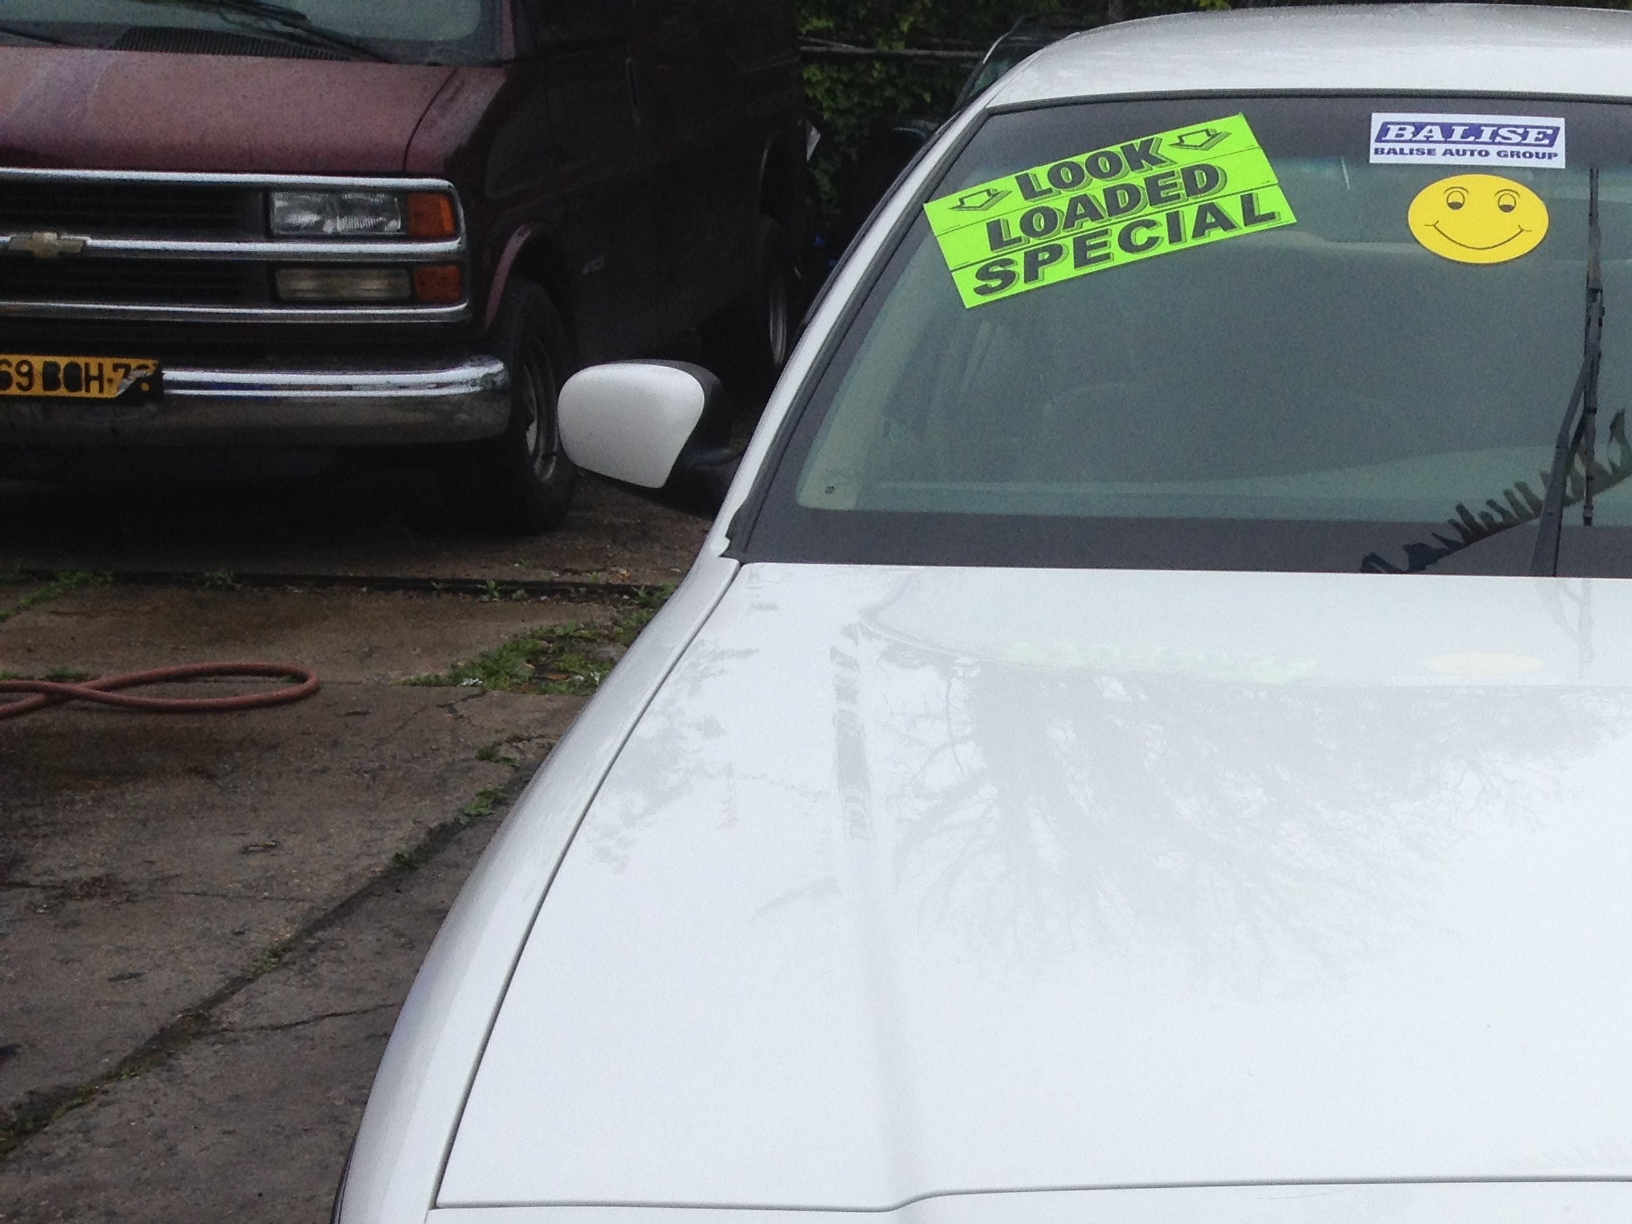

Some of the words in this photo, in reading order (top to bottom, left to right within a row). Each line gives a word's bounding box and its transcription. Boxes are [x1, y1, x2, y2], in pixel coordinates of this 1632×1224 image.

[1373, 147, 1437, 156] BALISE
[1441, 148, 1490, 157] AUTO
[1496, 149, 1559, 160] GROUP
[1381, 124, 1554, 145] BALISE
[1015, 137, 1176, 202] LOOK
[986, 163, 1227, 252] LOADED
[973, 192, 1281, 297] SPECIAL
